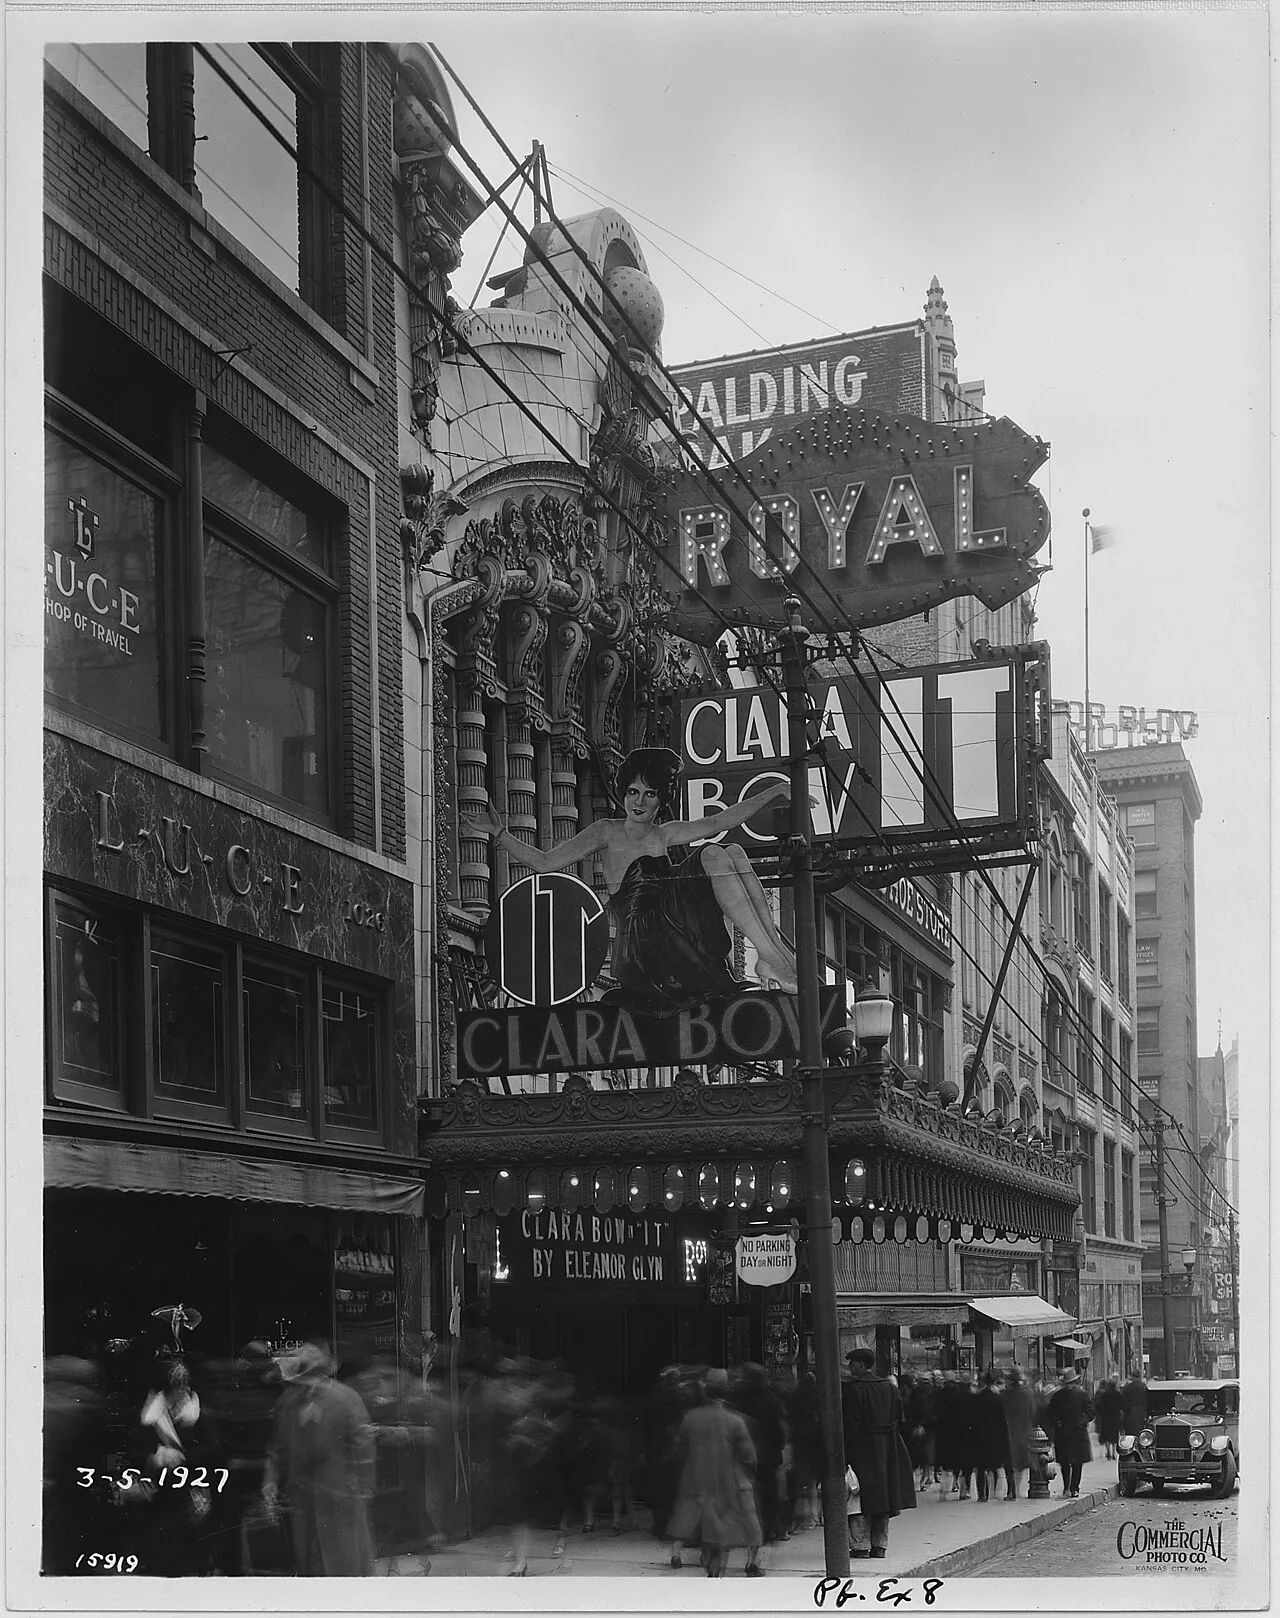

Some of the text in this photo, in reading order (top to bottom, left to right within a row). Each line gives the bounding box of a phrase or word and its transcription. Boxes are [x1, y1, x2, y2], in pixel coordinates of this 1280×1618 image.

[678, 464, 1008, 588] ROYAL
[44, 596, 133, 656] HOP OF TRAVEL
[879, 664, 1011, 828] IT
[879, 877, 951, 949] HOE STORE
[462, 1007, 648, 1075] CLARA
[521, 1208, 585, 1242] CLARA
[591, 1215, 625, 1245] BOW
[636, 1219, 670, 1248] "IT"
[742, 1238, 791, 1253] NO PARKING
[533, 1247, 664, 1282] BY ELEANOR GLYN
[740, 1255, 793, 1268] DAY OR NIGHT
